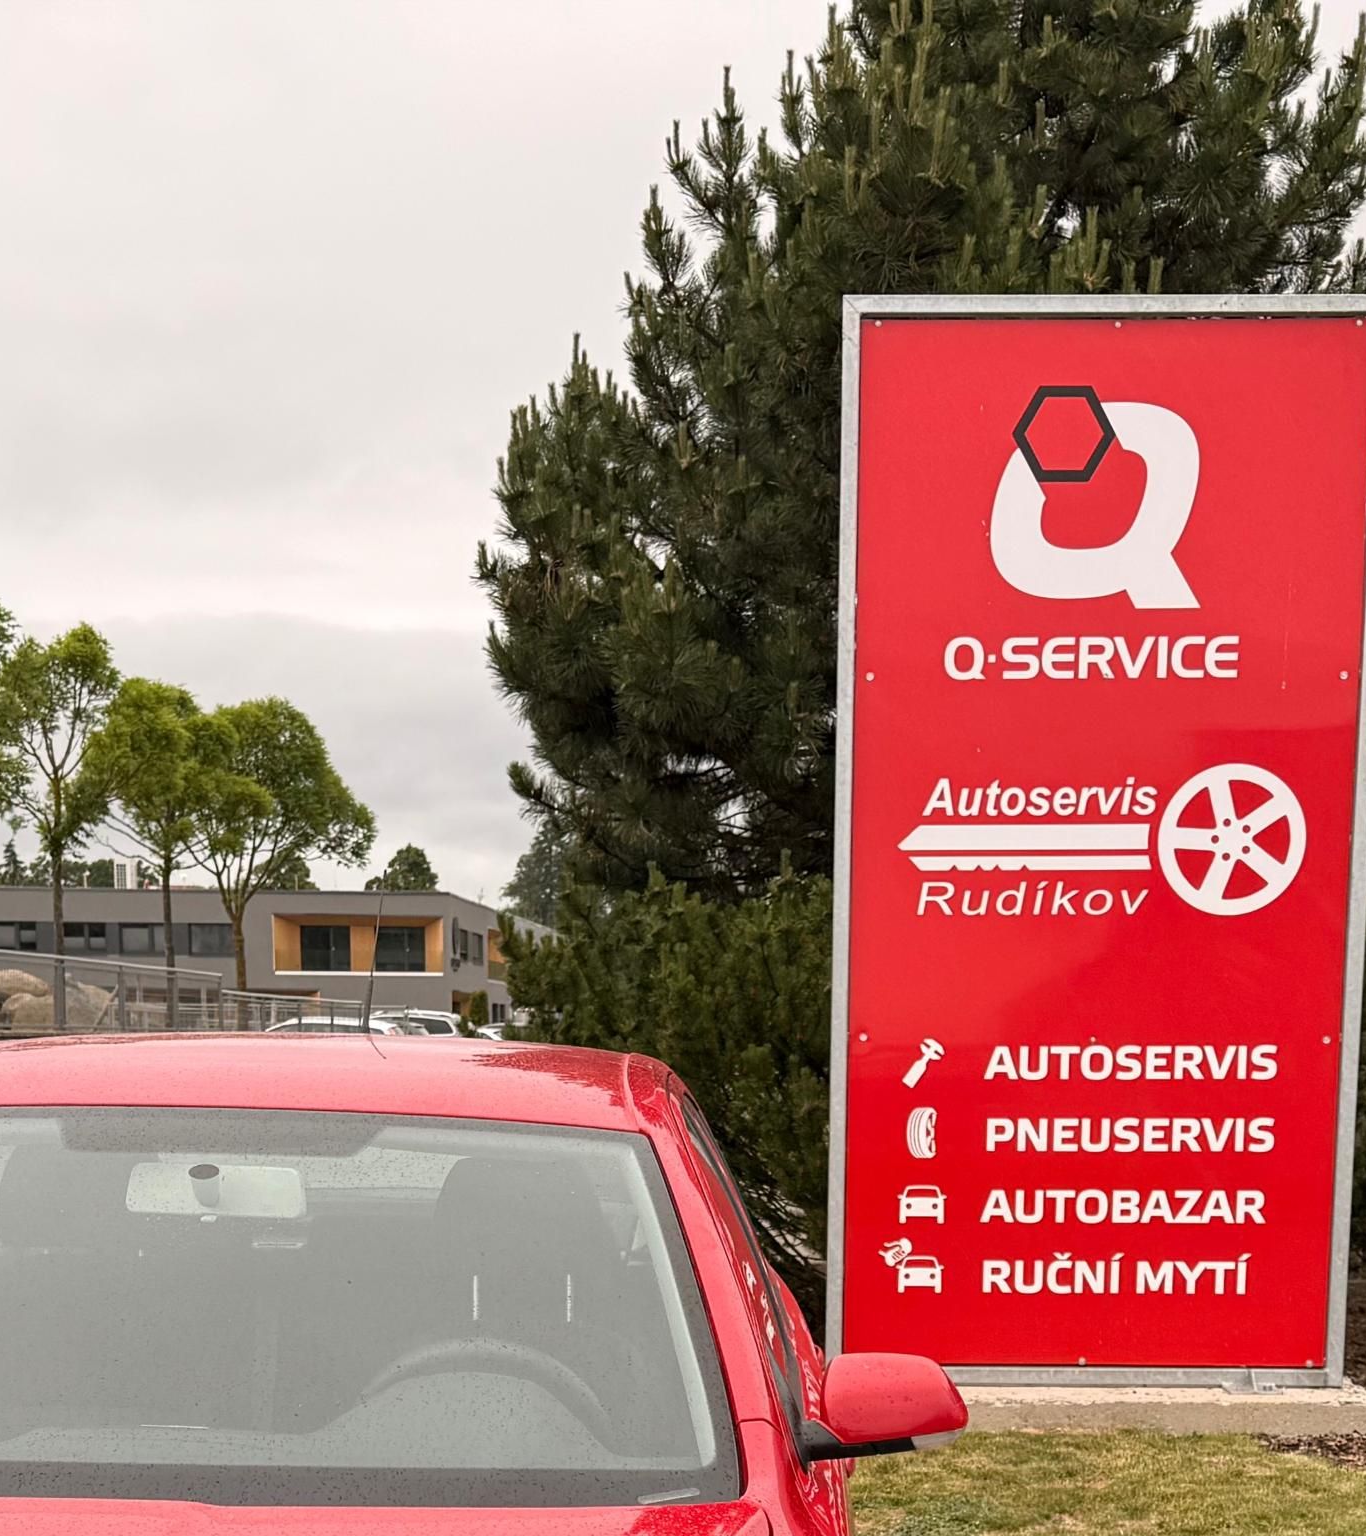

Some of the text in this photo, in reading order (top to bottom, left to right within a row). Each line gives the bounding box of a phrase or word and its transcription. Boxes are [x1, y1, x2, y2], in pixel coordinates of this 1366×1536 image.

[990, 386, 1201, 610] Q
[923, 776, 1158, 817] Autoservis
[917, 881, 1148, 916] Rudíkov
[984, 1044, 1278, 1081] AUTOSERVIS
[986, 1117, 1275, 1153] PNEUSERVIS
[980, 1189, 1266, 1224] AUTOBAZAR
[982, 1252, 1252, 1295] RUČNÍ MYTÍ
